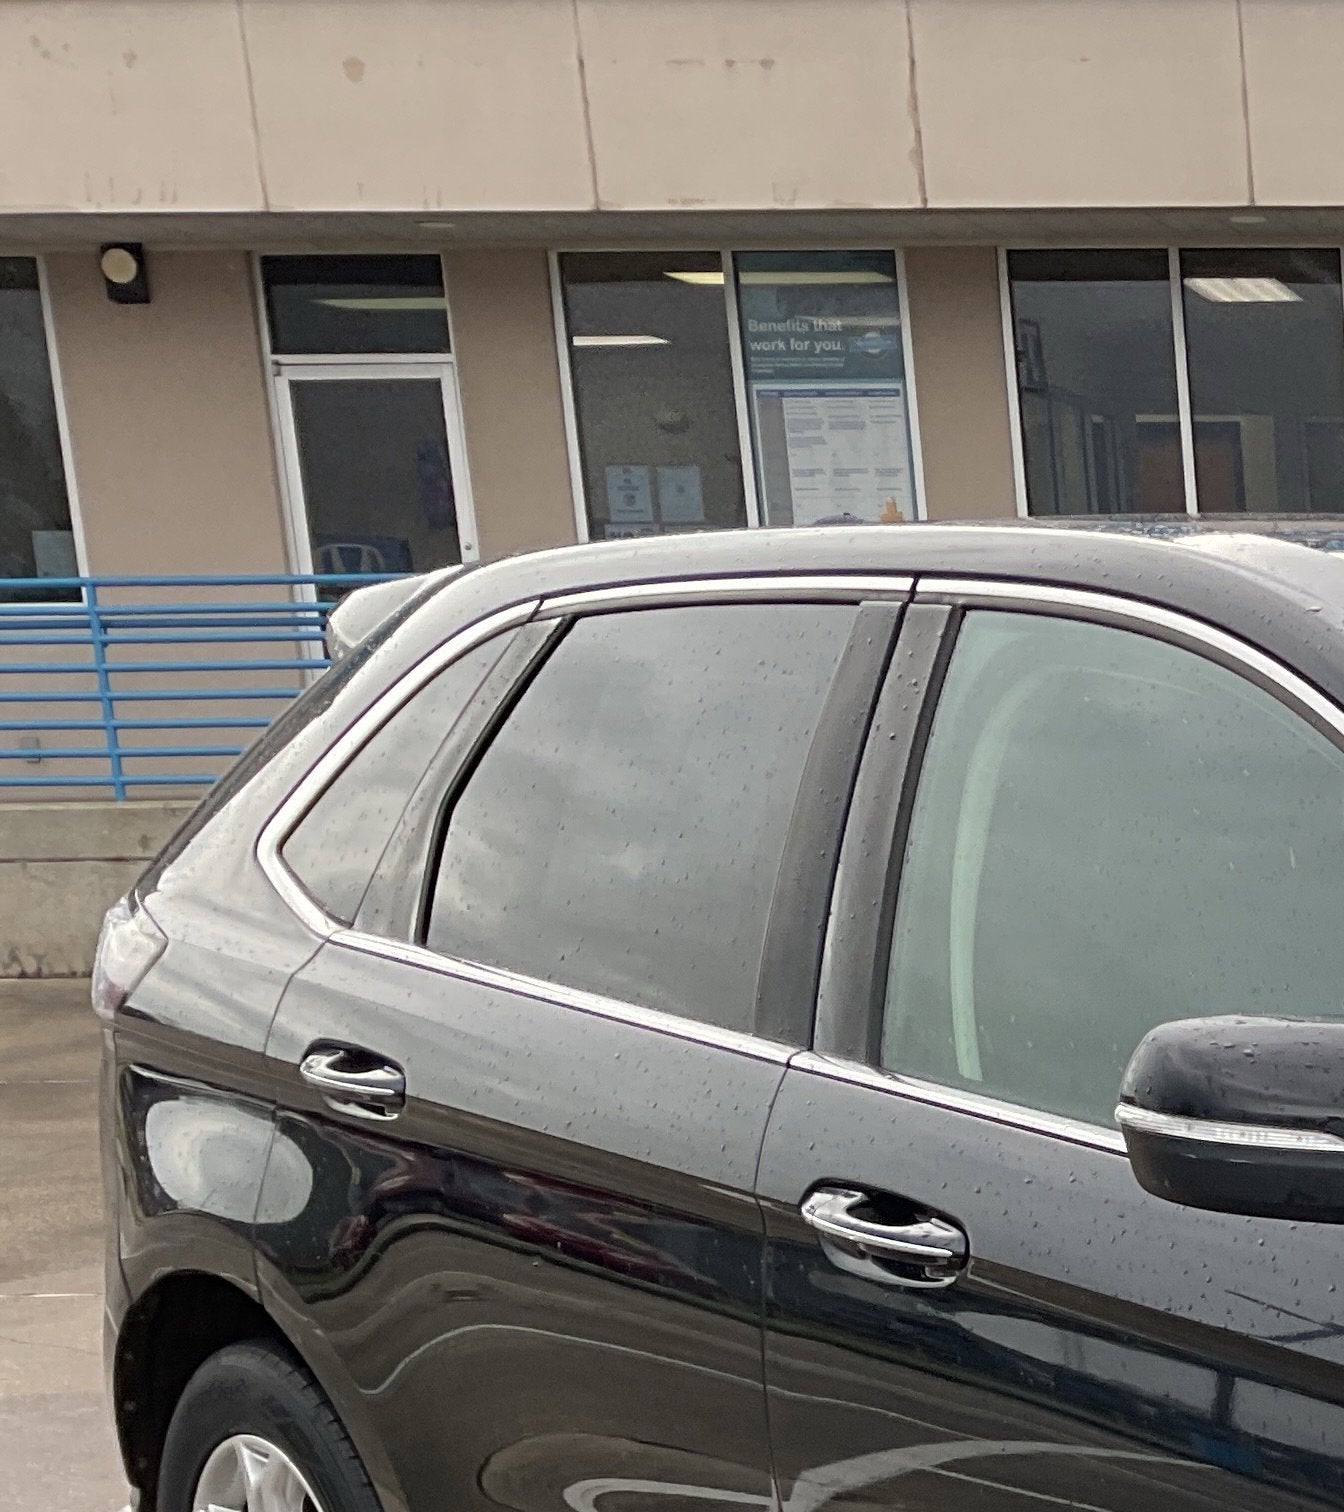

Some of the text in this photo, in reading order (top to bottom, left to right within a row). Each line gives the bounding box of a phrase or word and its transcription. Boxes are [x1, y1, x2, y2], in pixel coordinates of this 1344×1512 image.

[747, 319, 843, 332] Benefits that
[750, 338, 845, 354] work for you.
